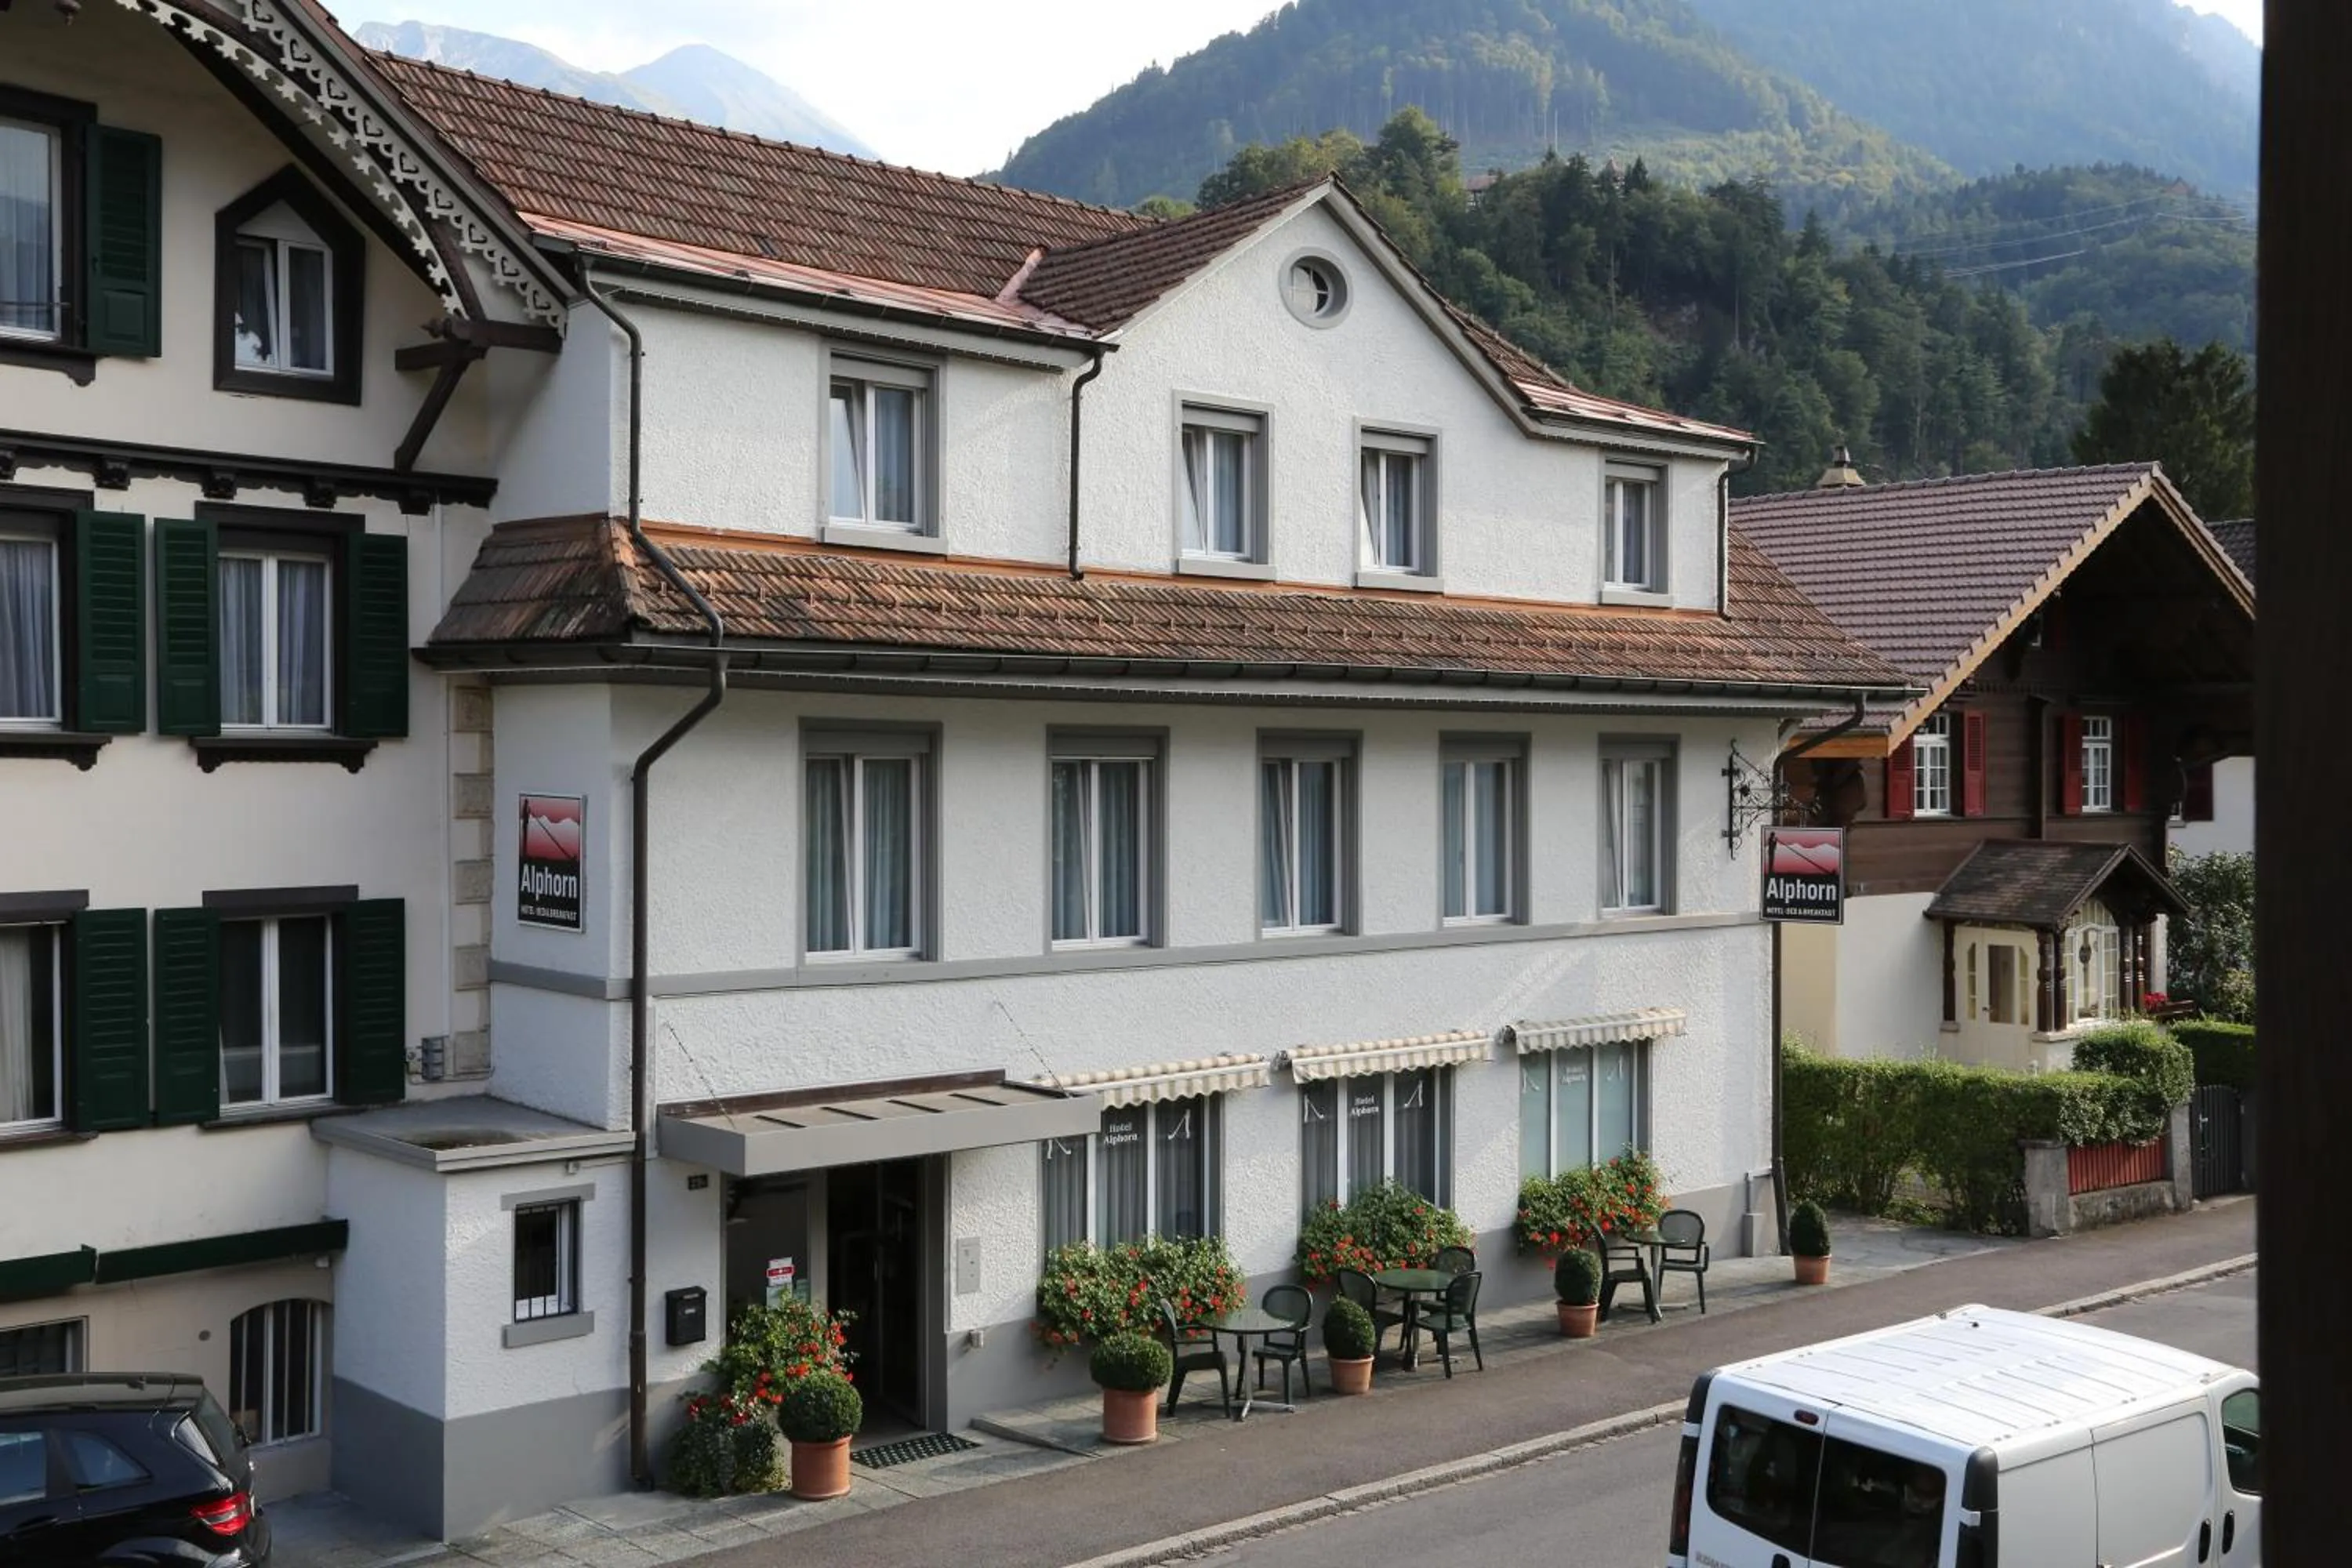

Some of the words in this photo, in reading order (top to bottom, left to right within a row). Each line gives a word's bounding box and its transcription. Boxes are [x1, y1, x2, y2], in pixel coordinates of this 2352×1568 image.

[521, 863, 577, 901] Alphorn
[1766, 877, 1836, 903] Alphorn
[1109, 1122, 1132, 1133] Hotel
[1103, 1134, 1138, 1145] Alphorn
